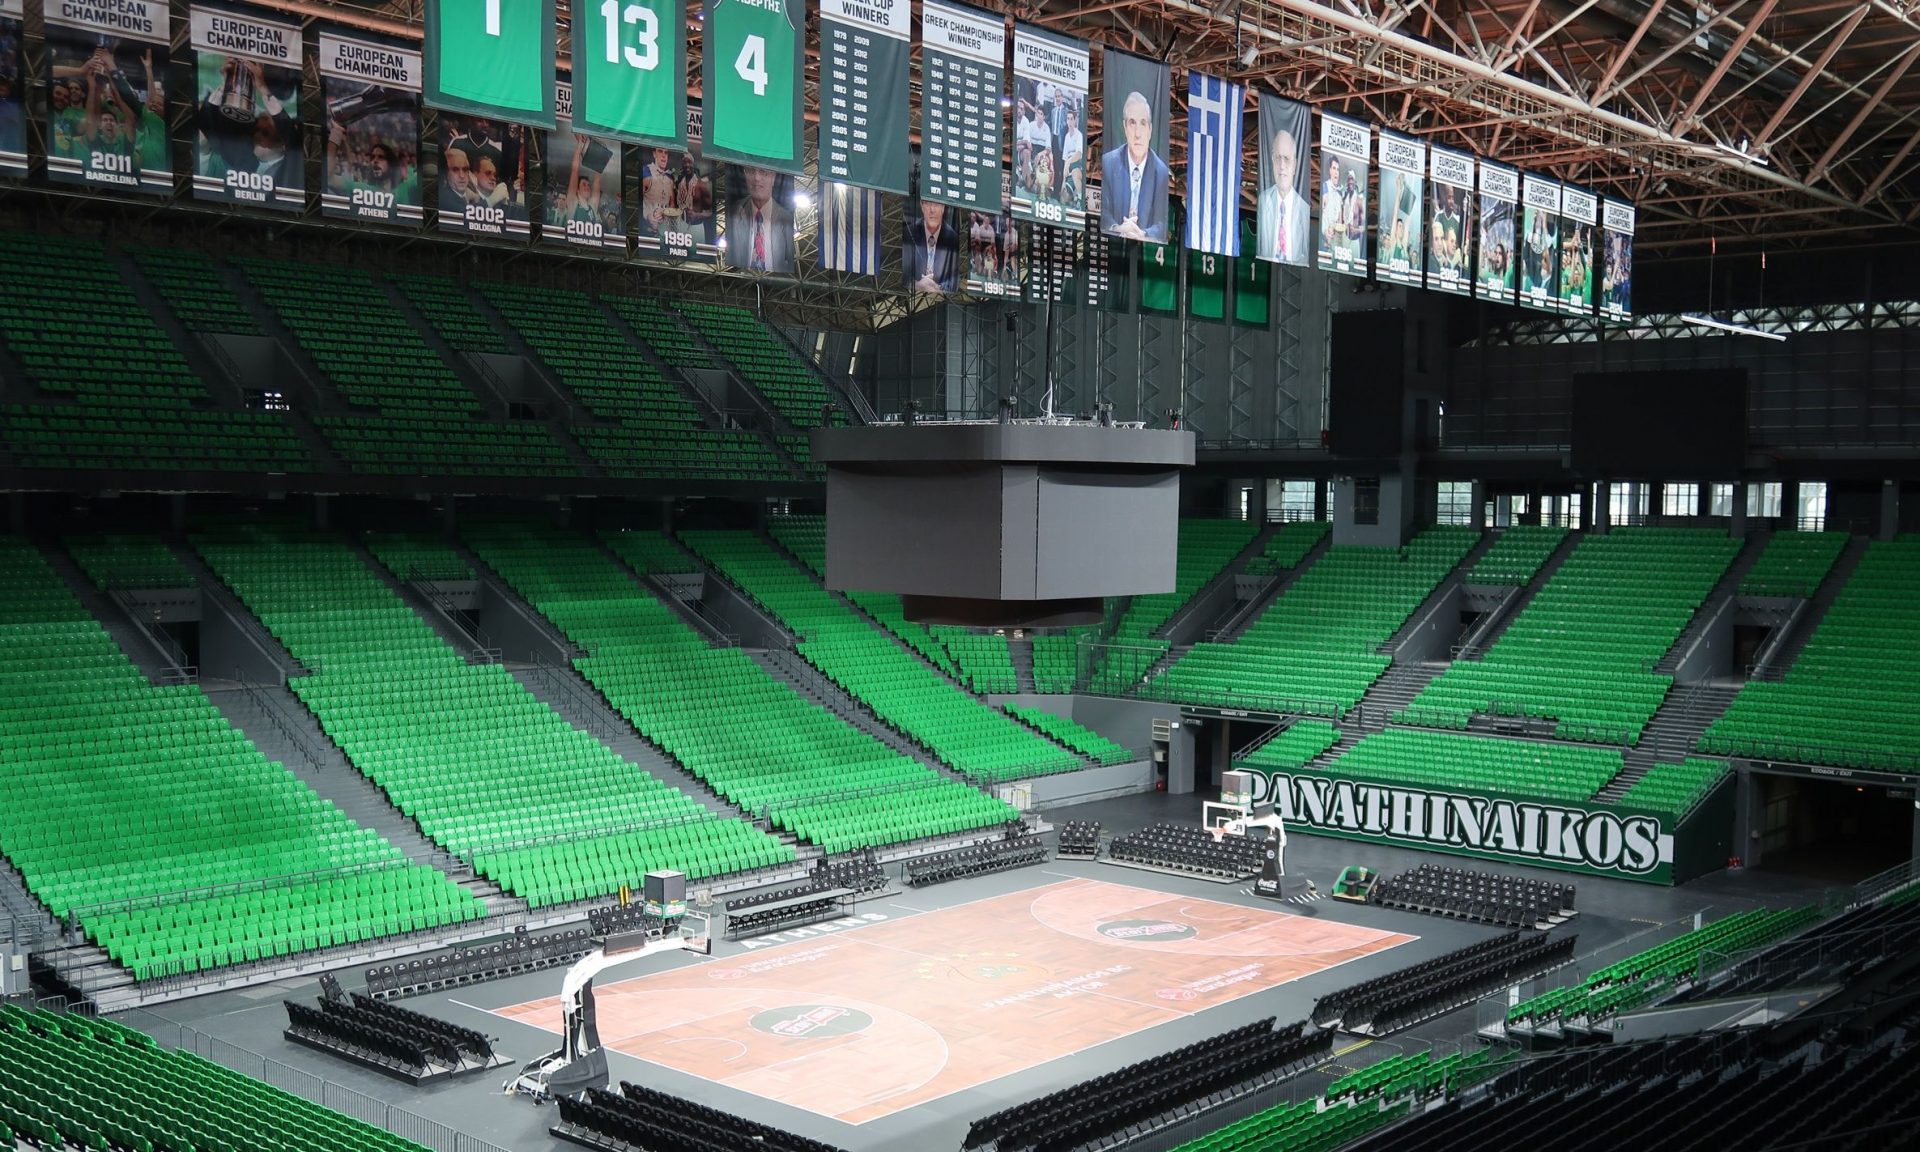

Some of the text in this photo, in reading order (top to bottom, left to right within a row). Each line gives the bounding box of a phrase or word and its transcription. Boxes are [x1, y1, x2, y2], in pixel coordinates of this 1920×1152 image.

[62, 4, 152, 33] CHAMPIONS
[842, 1, 890, 26] WINNERS
[212, 18, 283, 43] EUROPEAN
[601, 0, 659, 71] 13
[925, 14, 1003, 44] GREEK CHAMPIONSHIP
[207, 31, 288, 58] CHAMPIONS
[948, 32, 981, 50] WINNERS
[339, 44, 404, 68] EUROPEAN
[734, 34, 768, 96] 4
[1017, 41, 1085, 72] INTERCONTINENTAL
[335, 57, 408, 82] CHAMPIONS
[1026, 57, 1076, 80] CUP WINNERS
[1331, 124, 1362, 143] EUROPEAN
[1328, 135, 1363, 155] CHAMPIONS
[1388, 142, 1416, 159] EUROPEAN
[91, 151, 131, 173] 2011
[1385, 152, 1418, 170] CHAMPIONS
[1439, 156, 1466, 172] EUROPEAN
[85, 171, 138, 186] BARCELONA
[226, 169, 274, 192] 2009
[1436, 166, 1468, 183] CHAMPIONS
[1486, 170, 1511, 186] EUROPEAN
[235, 189, 266, 201] BERLIN
[1484, 180, 1513, 196] CHAMPIONS
[1530, 183, 1554, 197] EUROPEAN
[352, 188, 394, 209] 2007
[1528, 193, 1555, 208] CHAMPIONS
[1569, 194, 1591, 208] EUROPEAN
[358, 207, 389, 219] ATHENS
[465, 204, 505, 224] 2002
[1034, 200, 1062, 222] 1996
[1567, 203, 1592, 218] CHAMPIONS
[1609, 206, 1630, 220] EUROPEAN
[469, 222, 501, 233] BOLOGNA
[567, 219, 602, 238] 2000
[1607, 215, 1631, 229] CHAMPIONS
[664, 230, 693, 247] 1996
[669, 247, 687, 257] PARIS
[1155, 246, 1164, 267] 4
[1334, 245, 1353, 262] 1996
[1201, 254, 1215, 276] 13
[1250, 262, 1256, 281] 1
[1440, 266, 1459, 282] 2002
[983, 281, 1004, 295] 1996
[1237, 769, 1661, 873] PANATHINAIKOS
[740, 913, 888, 949] ATHENS
